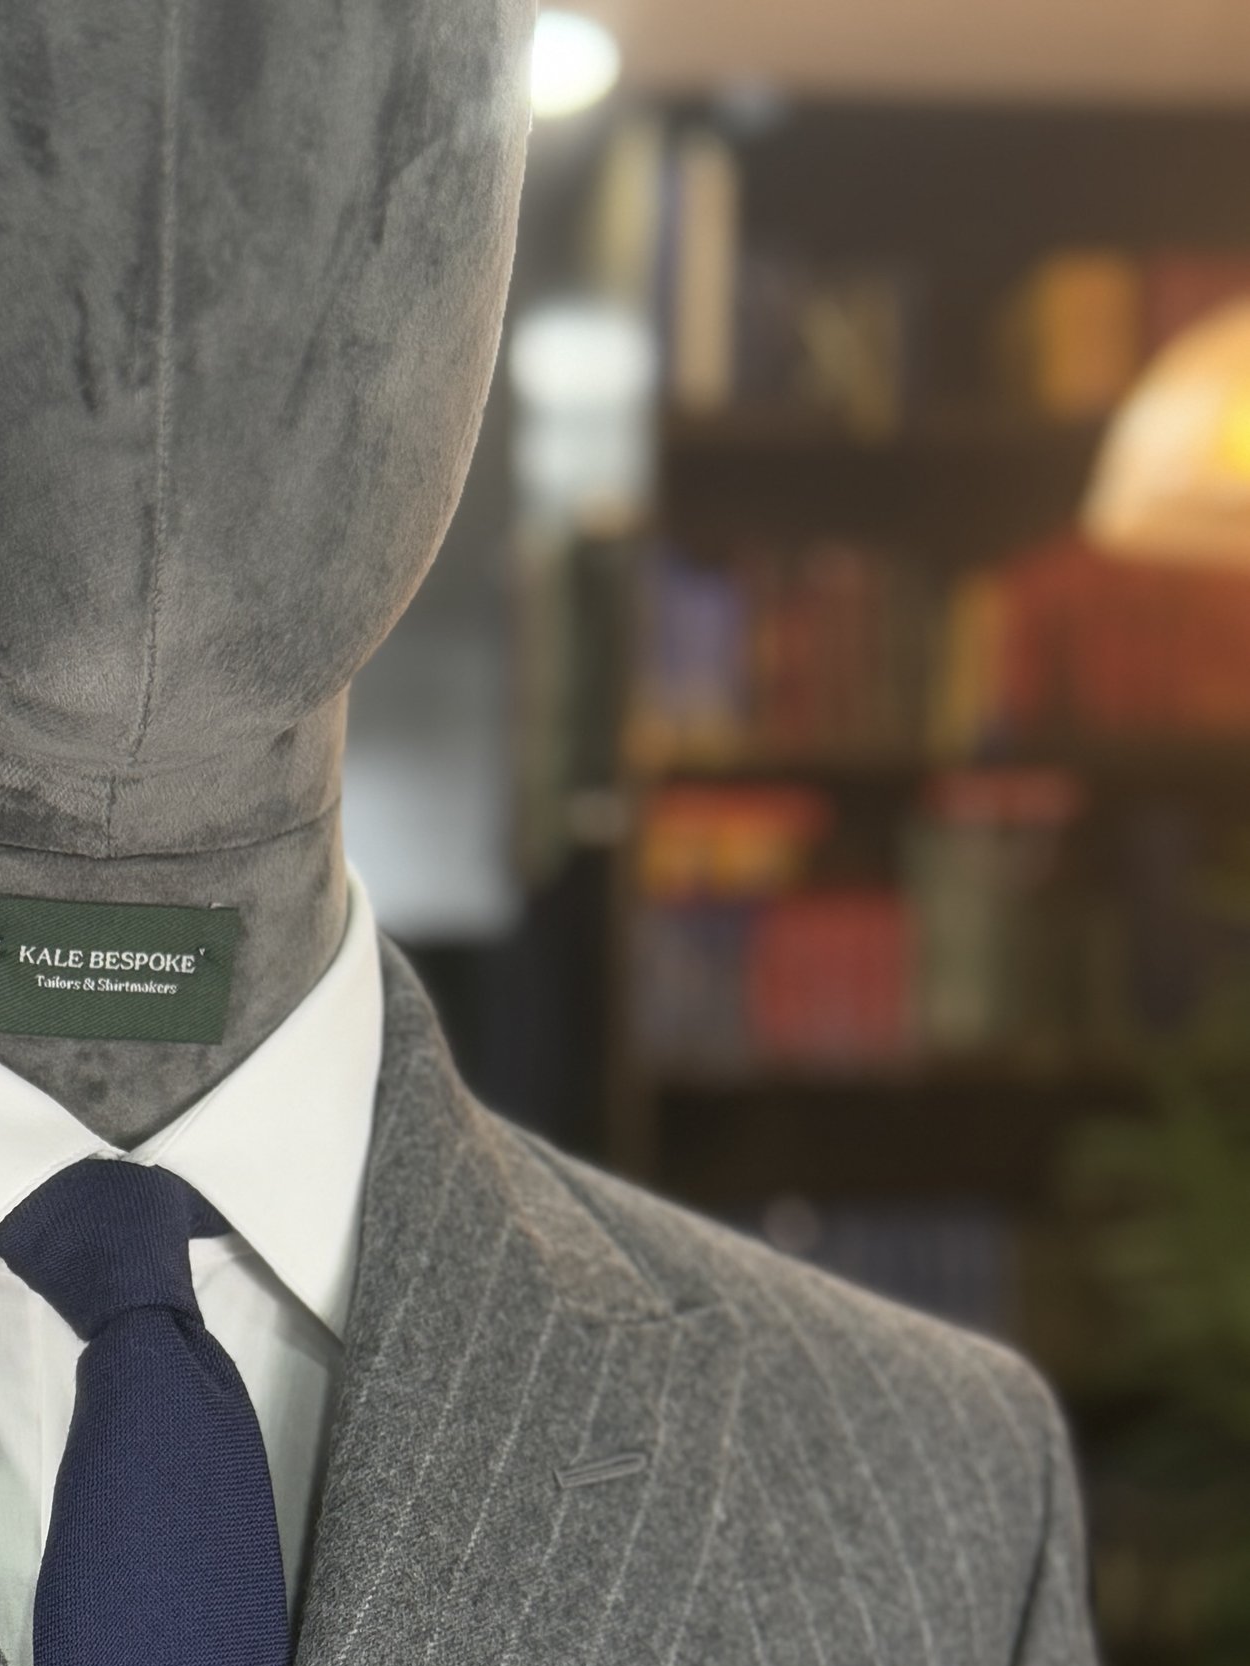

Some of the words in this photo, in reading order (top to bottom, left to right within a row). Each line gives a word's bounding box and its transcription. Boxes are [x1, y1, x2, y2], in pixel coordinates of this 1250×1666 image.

[19, 945, 84, 968] KALE
[89, 951, 196, 974] BESPOKE
[35, 974, 81, 990] Tailors
[82, 977, 95, 991] &
[97, 977, 178, 994] Shirtmakers
